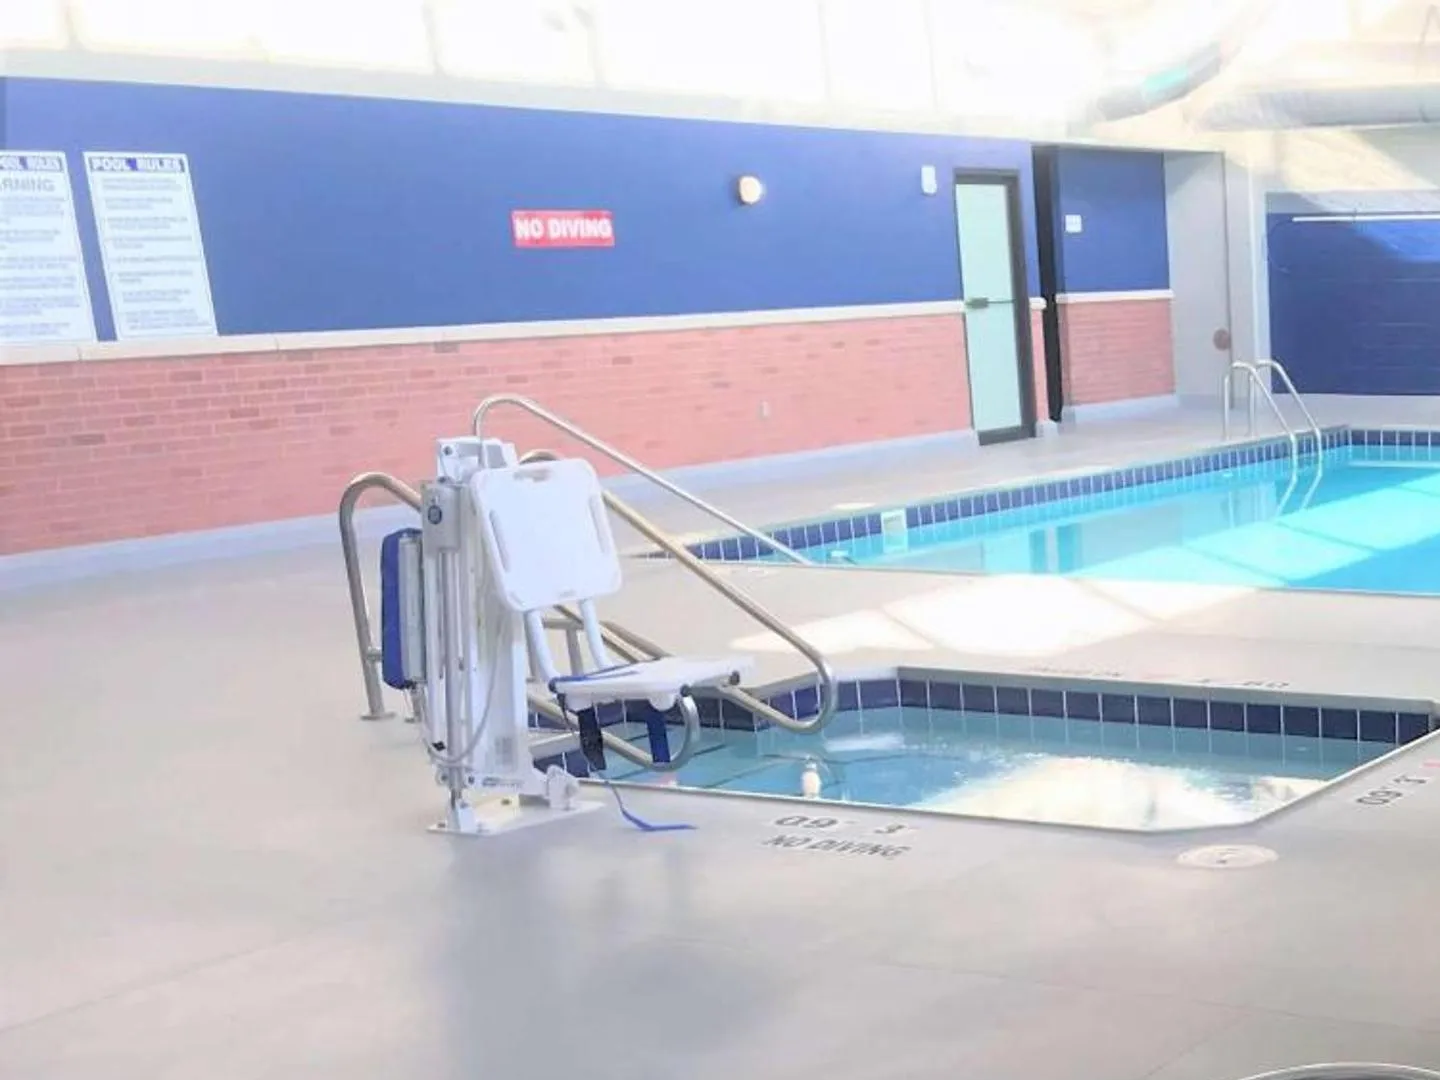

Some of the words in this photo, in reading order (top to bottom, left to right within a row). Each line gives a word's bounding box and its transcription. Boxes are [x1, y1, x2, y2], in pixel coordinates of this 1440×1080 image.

[91, 157, 132, 171] POOL
[0, 178, 56, 193] RNING
[514, 217, 545, 240] NO
[547, 217, 613, 239] DIVING
